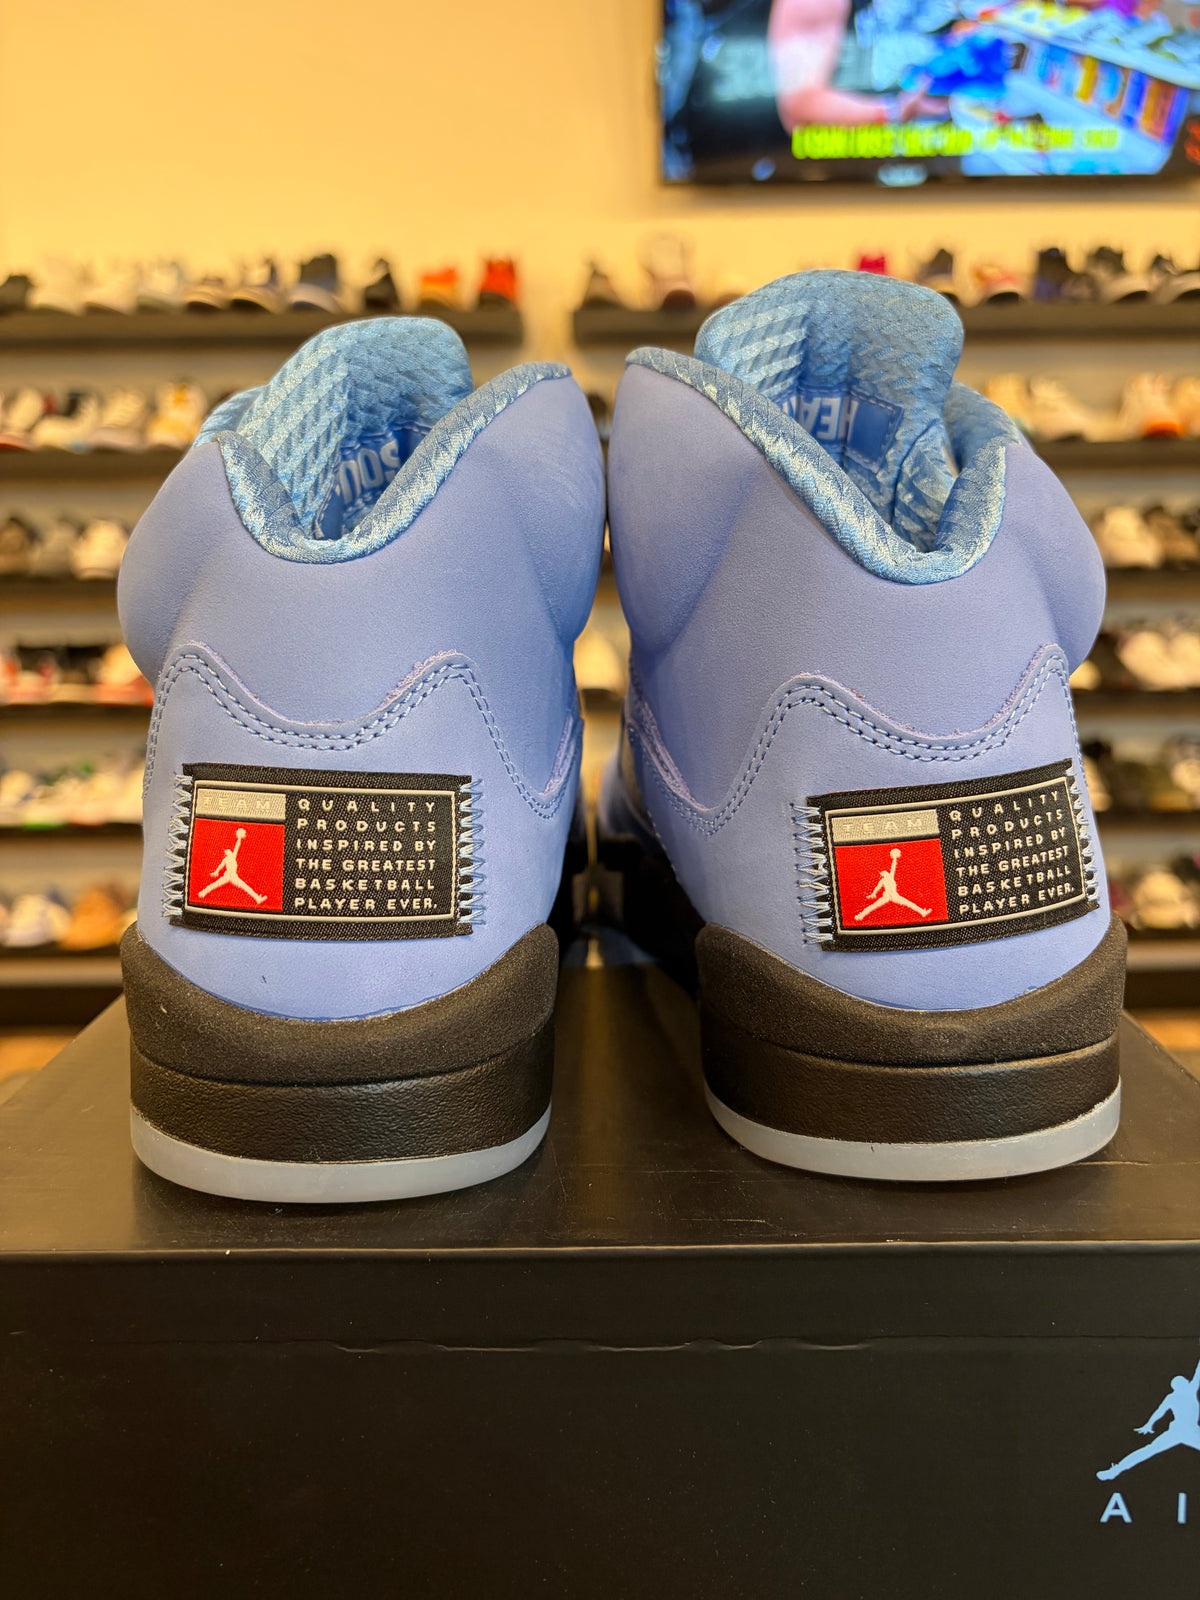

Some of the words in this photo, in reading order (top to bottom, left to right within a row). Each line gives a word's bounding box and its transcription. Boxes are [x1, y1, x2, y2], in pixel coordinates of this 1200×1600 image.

[336, 440, 399, 505] SOU
[202, 796, 271, 810] TEAM
[298, 799, 435, 813] QUALITY
[949, 791, 1059, 822] QUALITY
[297, 818, 436, 833] PRODUCTS
[843, 818, 922, 834] TEAM
[951, 810, 1063, 840] PRODUCTS
[296, 839, 403, 851] INSPIRED
[415, 840, 436, 851] BY
[953, 833, 1044, 859] INSPIRED
[1051, 826, 1066, 840] BY
[296, 858, 332, 870] THE
[343, 859, 436, 872] GREATEST
[955, 863, 990, 879] THE
[998, 845, 1069, 872] GREATEST
[295, 878, 435, 891] BASKETBALL
[957, 864, 1071, 898] BASKETBALL
[295, 897, 375, 911] PLAYER
[387, 898, 438, 911] EVER.
[959, 895, 1030, 915] PLAYER
[1038, 882, 1075, 902] EVER.
